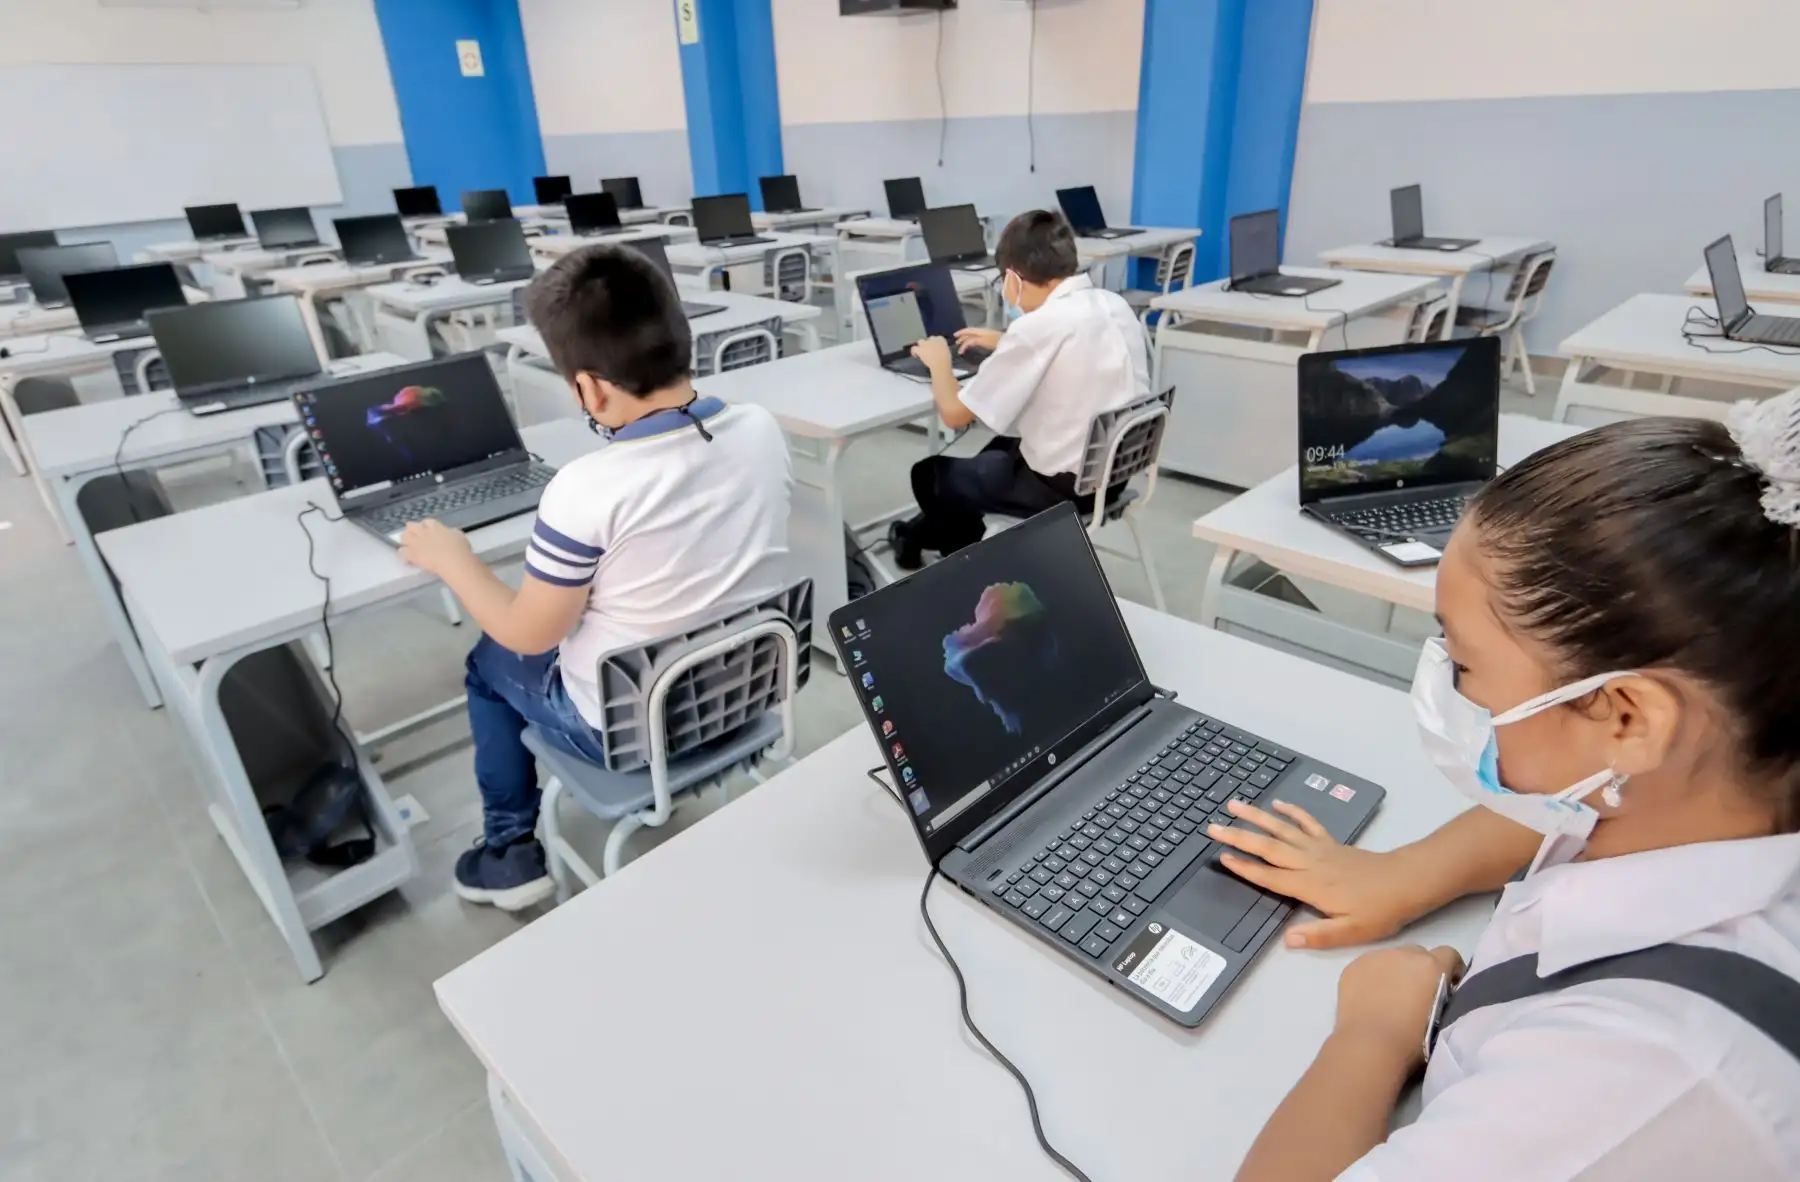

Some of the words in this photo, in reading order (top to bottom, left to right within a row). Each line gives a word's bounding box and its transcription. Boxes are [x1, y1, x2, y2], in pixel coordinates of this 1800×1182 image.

[682, 2, 692, 22] S
[1306, 444, 1345, 462] 09:44
[1122, 952, 1136, 965] Laptop
